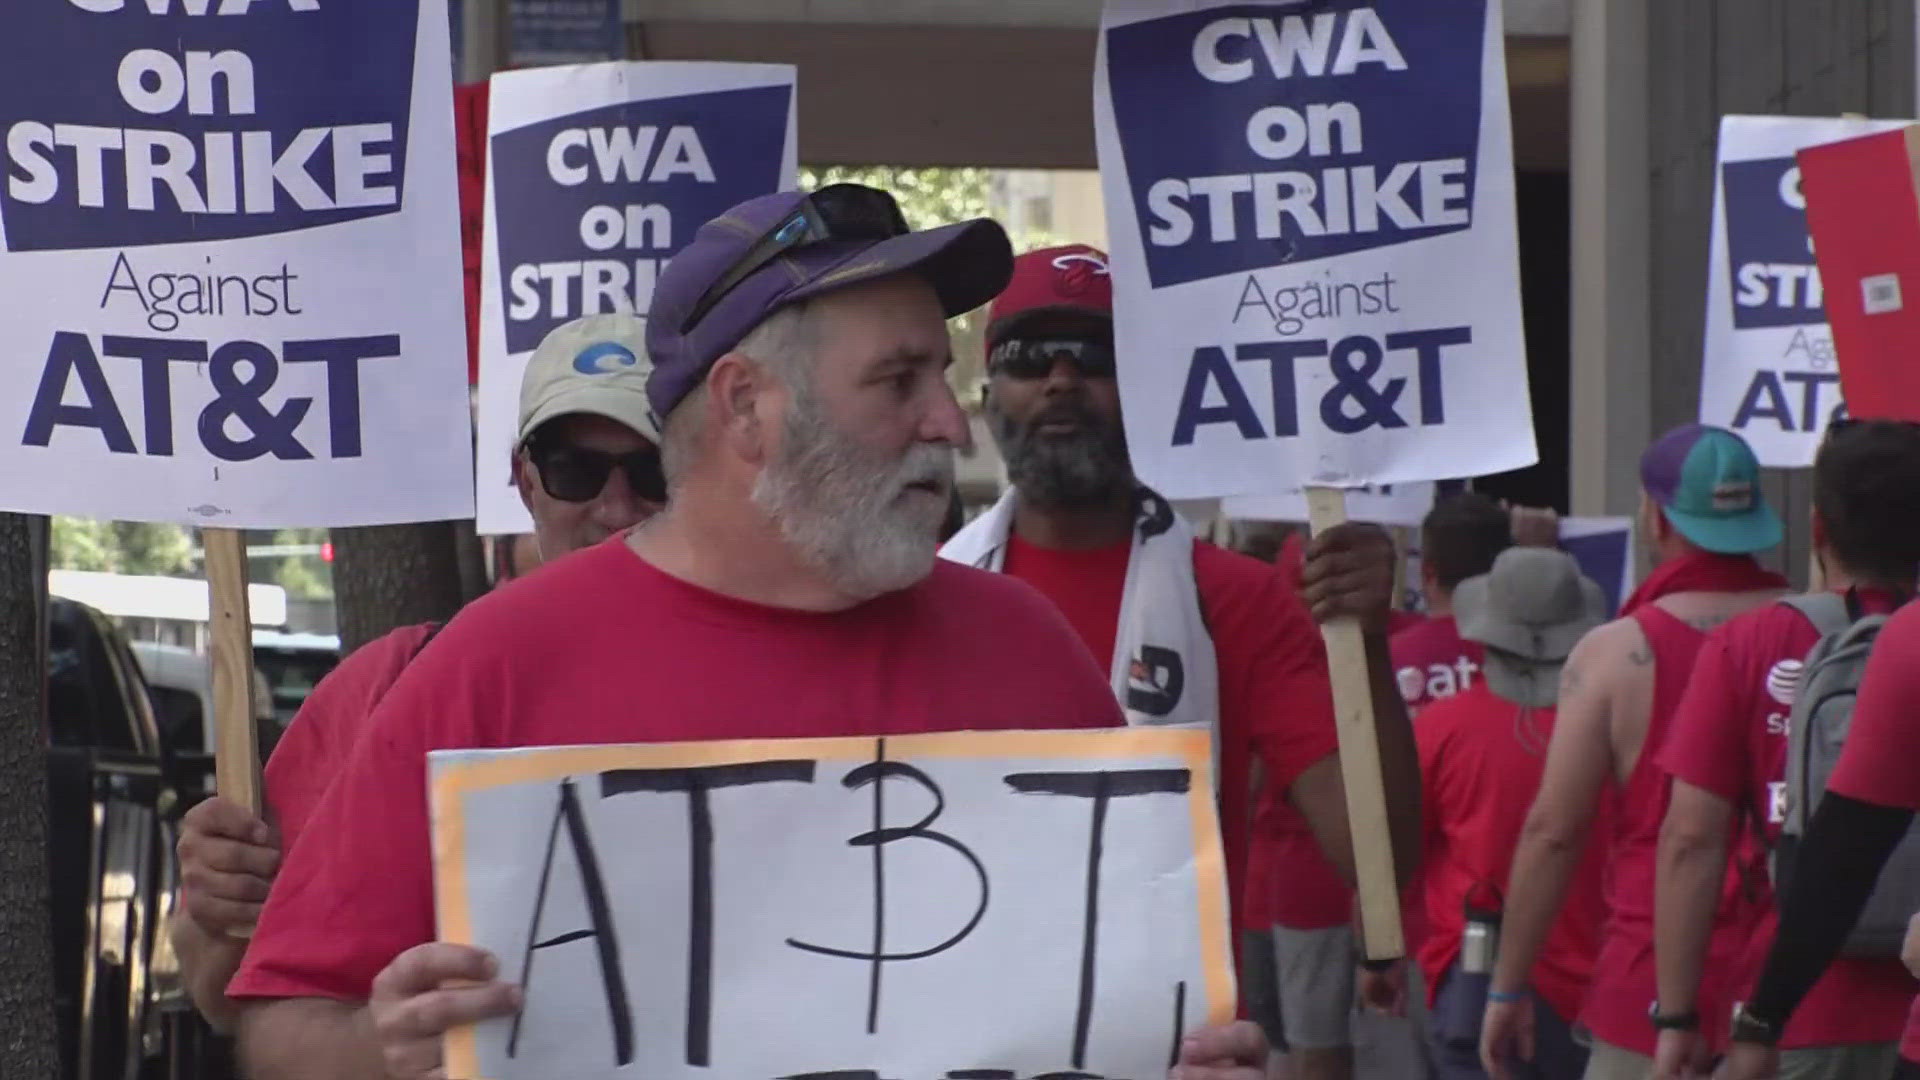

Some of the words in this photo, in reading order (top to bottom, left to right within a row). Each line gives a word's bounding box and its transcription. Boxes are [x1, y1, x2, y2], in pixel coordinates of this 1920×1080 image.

[1192, 7, 1408, 83] CWA
[117, 48, 256, 115] on
[546, 125, 716, 187] CWA
[1246, 101, 1363, 160] on
[6, 120, 397, 214] STRIKE
[1147, 157, 1469, 247] STRIKE
[578, 203, 672, 251] on
[100, 251, 303, 333] Against
[509, 258, 672, 321] STRI
[1231, 271, 1401, 337] Against
[21, 330, 402, 462] AT&T
[1171, 326, 1473, 447] AT&T
